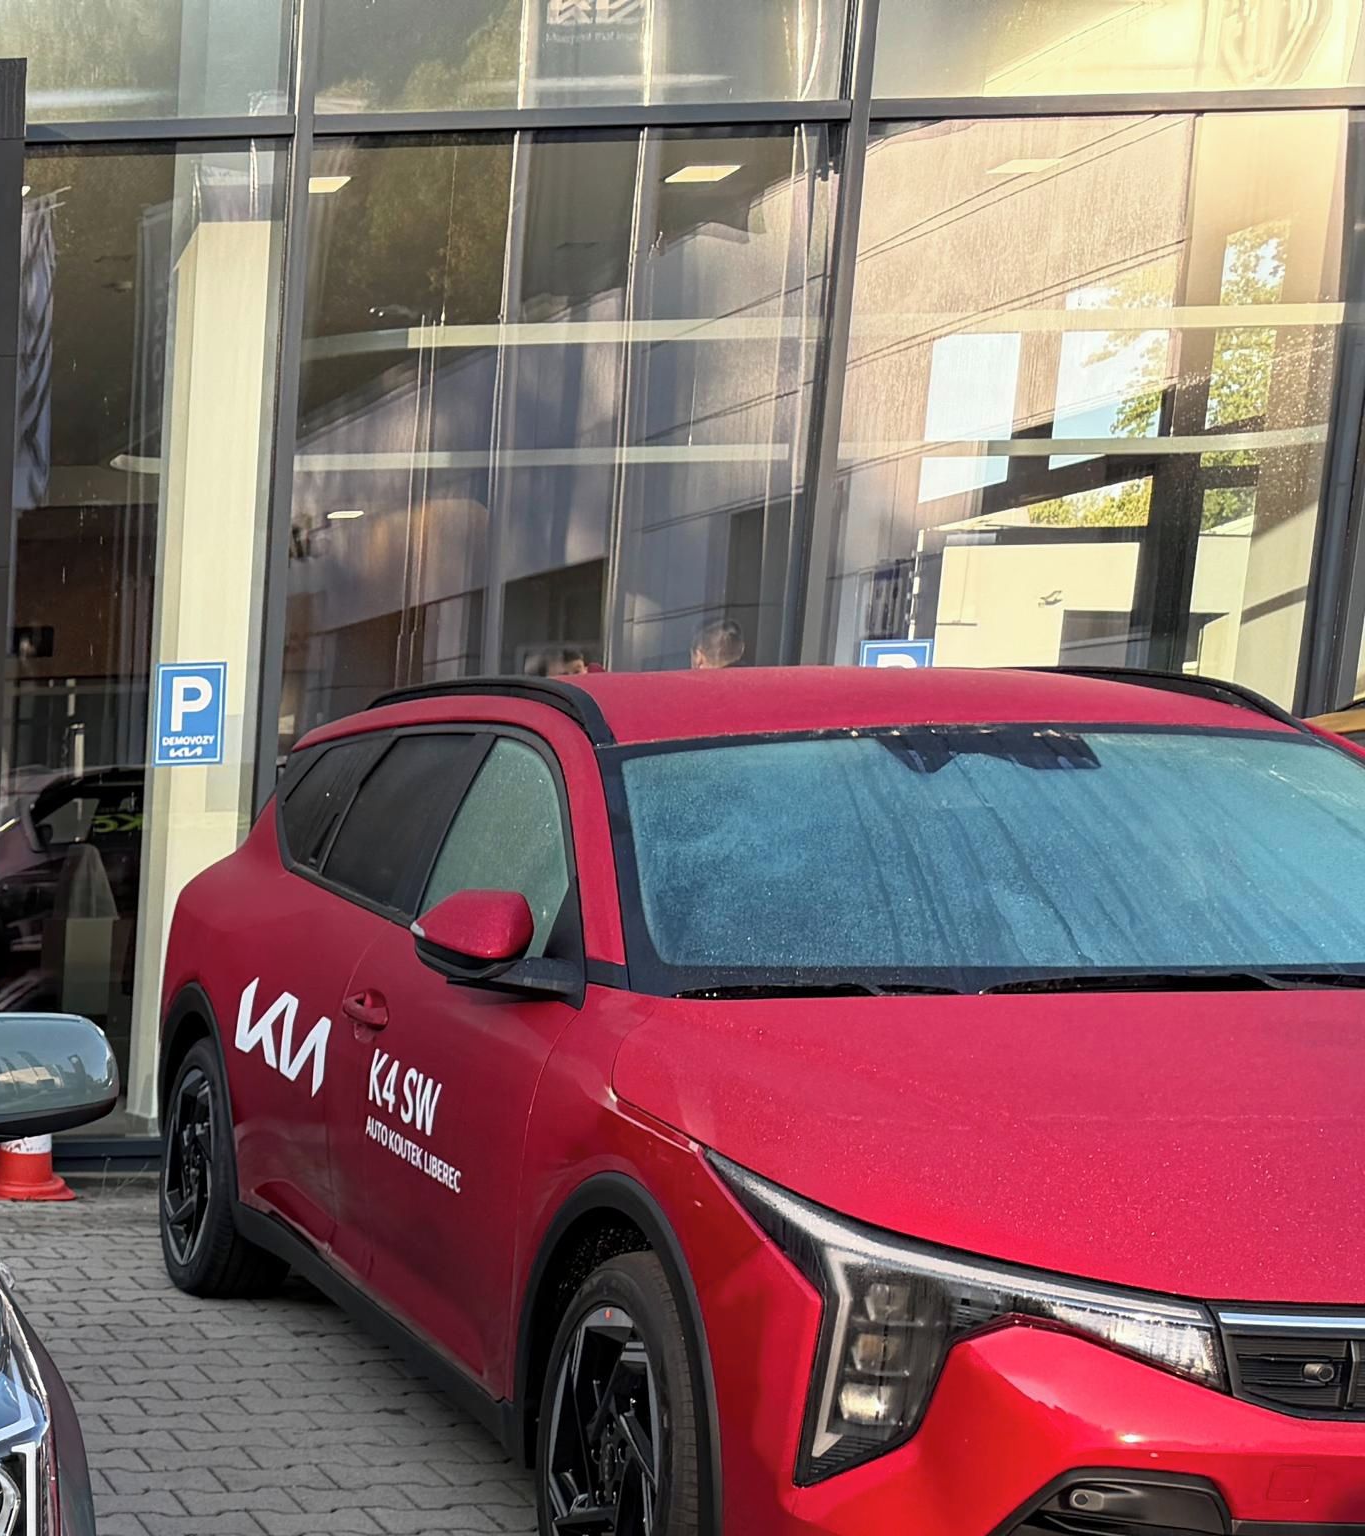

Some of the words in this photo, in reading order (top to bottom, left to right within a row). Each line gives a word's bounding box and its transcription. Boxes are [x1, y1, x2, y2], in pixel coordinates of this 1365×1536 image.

[170, 675, 213, 732] P
[161, 735, 216, 747] DEMOVOZY
[169, 746, 203, 758] KIA
[234, 976, 332, 1098] KIA
[368, 1048, 400, 1114] K4
[400, 1067, 443, 1136] SW
[365, 1115, 388, 1147] AUTO
[388, 1129, 423, 1170] KOUTEK
[423, 1151, 462, 1194] LIBEREC
